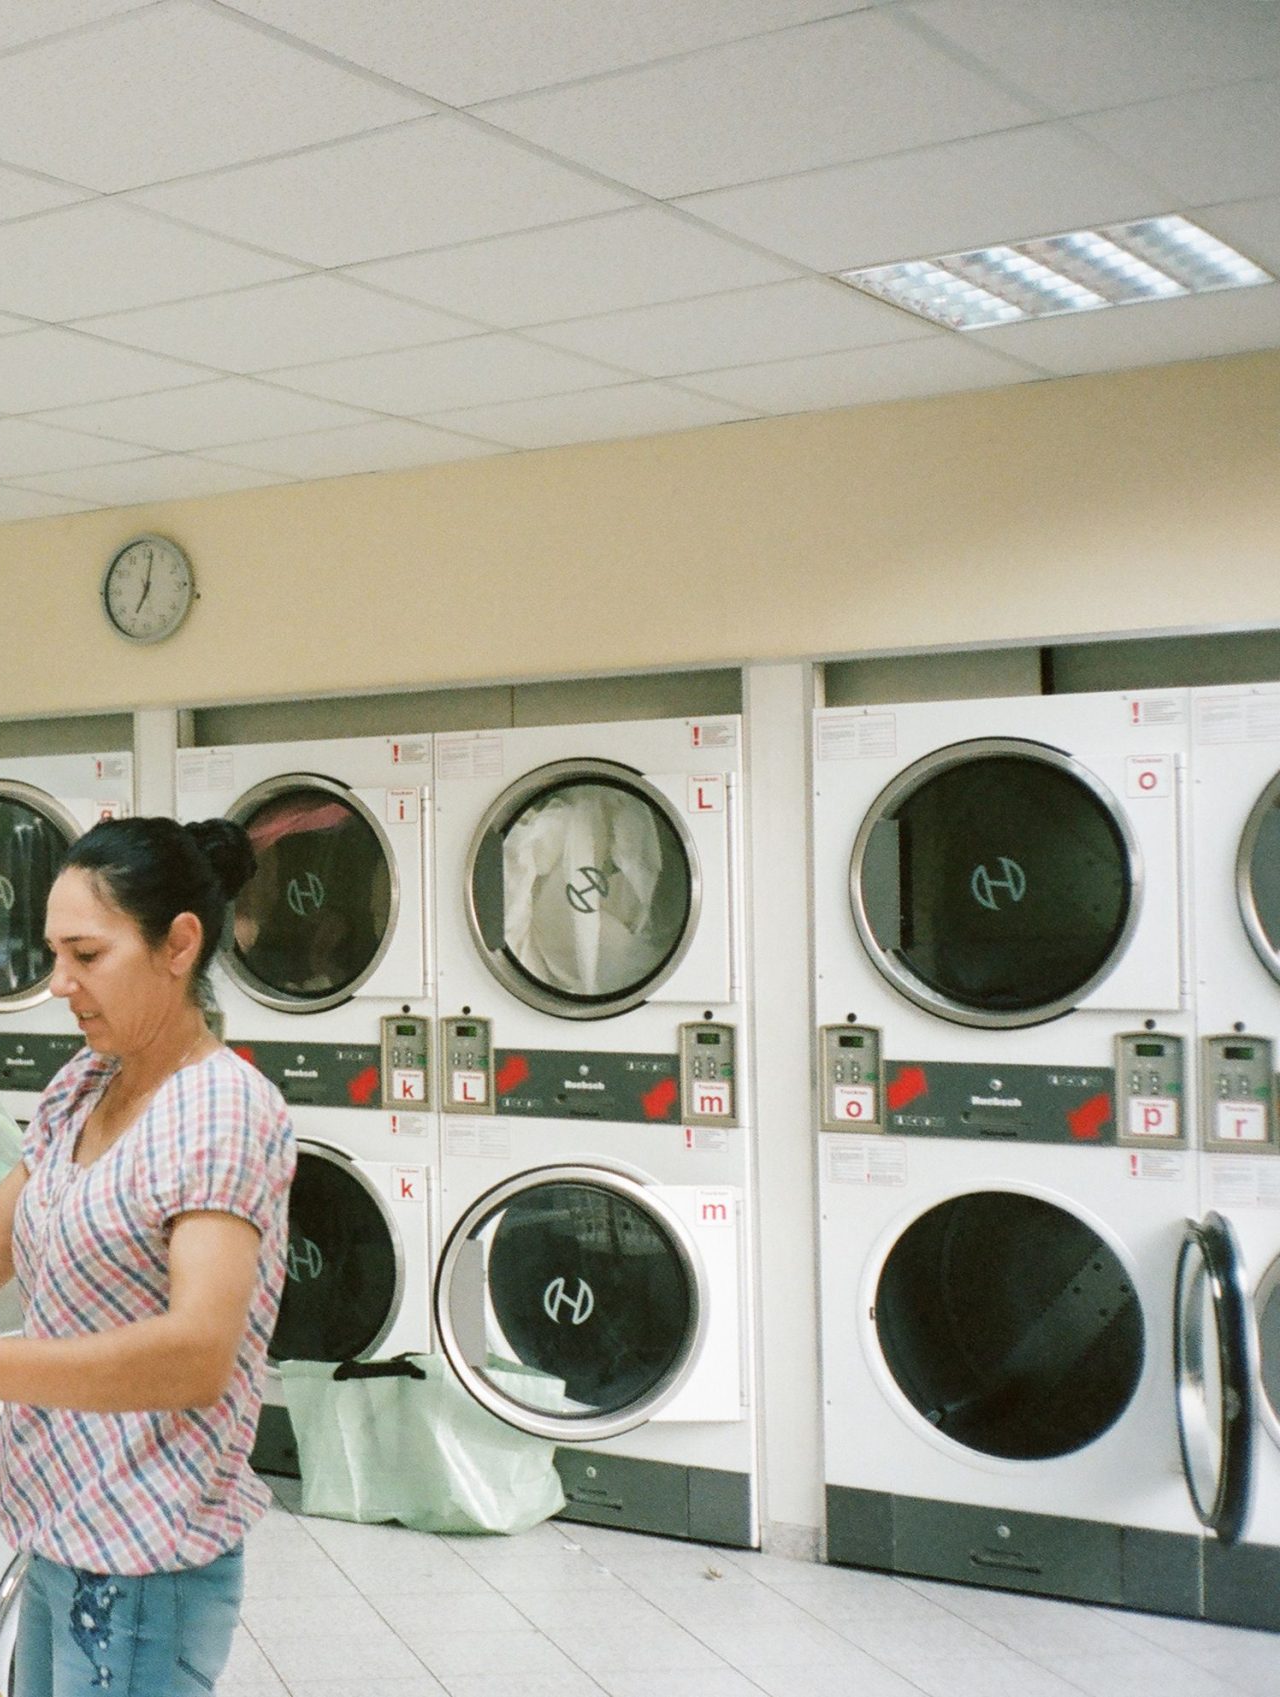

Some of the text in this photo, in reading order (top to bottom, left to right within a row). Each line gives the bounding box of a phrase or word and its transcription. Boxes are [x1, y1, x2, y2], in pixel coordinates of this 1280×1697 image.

[697, 787, 713, 810] L
[399, 799, 405, 820] i
[402, 1079, 415, 1099] k
[462, 1082, 476, 1101] L
[700, 1095, 724, 1113] m
[1143, 1107, 1163, 1133] p
[1234, 1118, 1249, 1138] r
[401, 1178, 413, 1198] k
[702, 1203, 727, 1220] m
